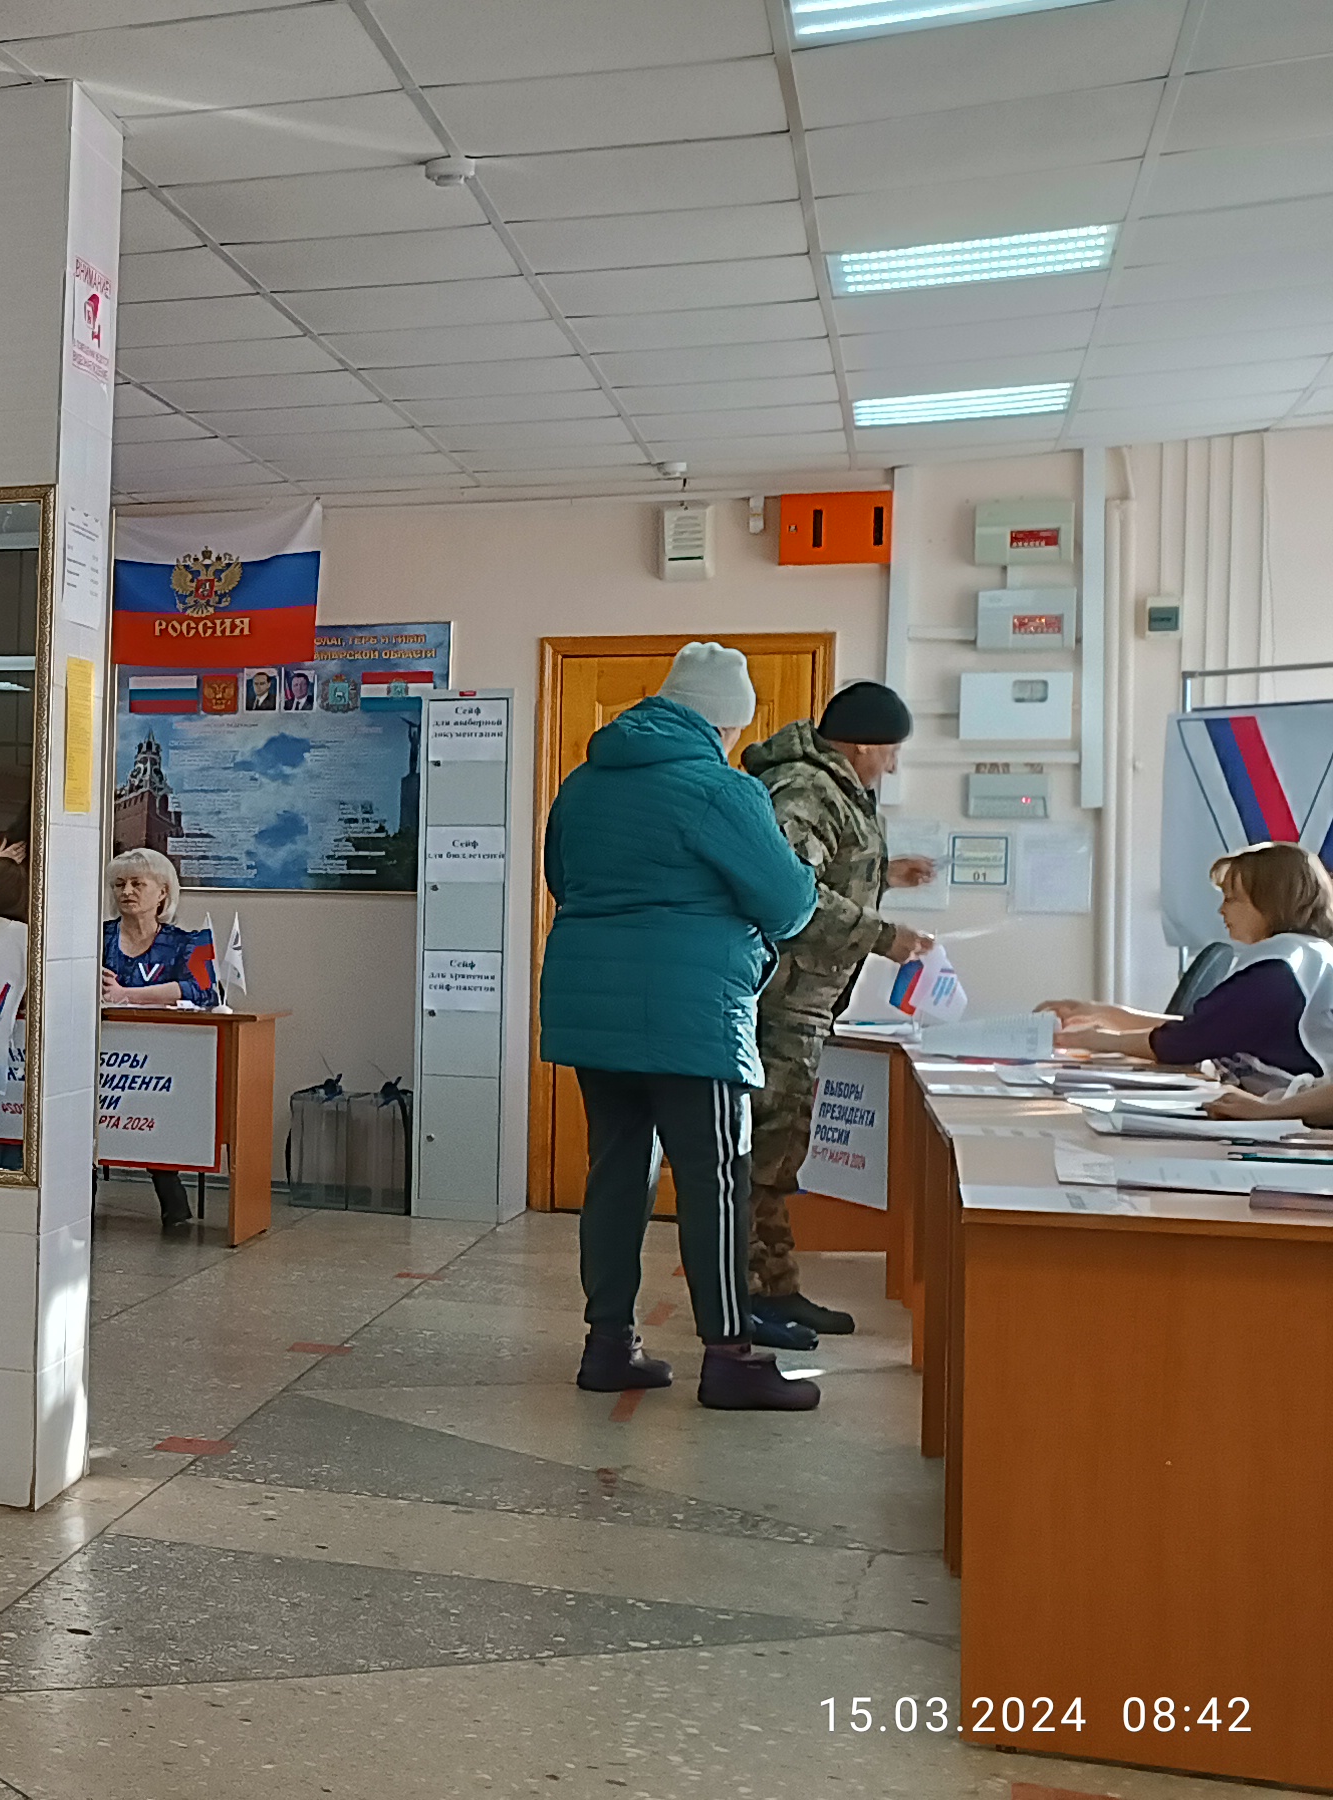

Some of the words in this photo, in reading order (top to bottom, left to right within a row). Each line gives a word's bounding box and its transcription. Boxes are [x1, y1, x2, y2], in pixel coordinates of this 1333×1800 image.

[154, 617, 251, 637] РОССИЯ
[454, 706, 481, 716] Сейф
[451, 839, 479, 849] Сейф
[449, 959, 476, 970] Сейф
[823, 1079, 864, 1100] ВЫБОРЫ
[819, 1102, 875, 1127] ПРЕЗИДЕНТА
[122, 1116, 155, 1131] 2024
[814, 1125, 850, 1146] РОССИИ
